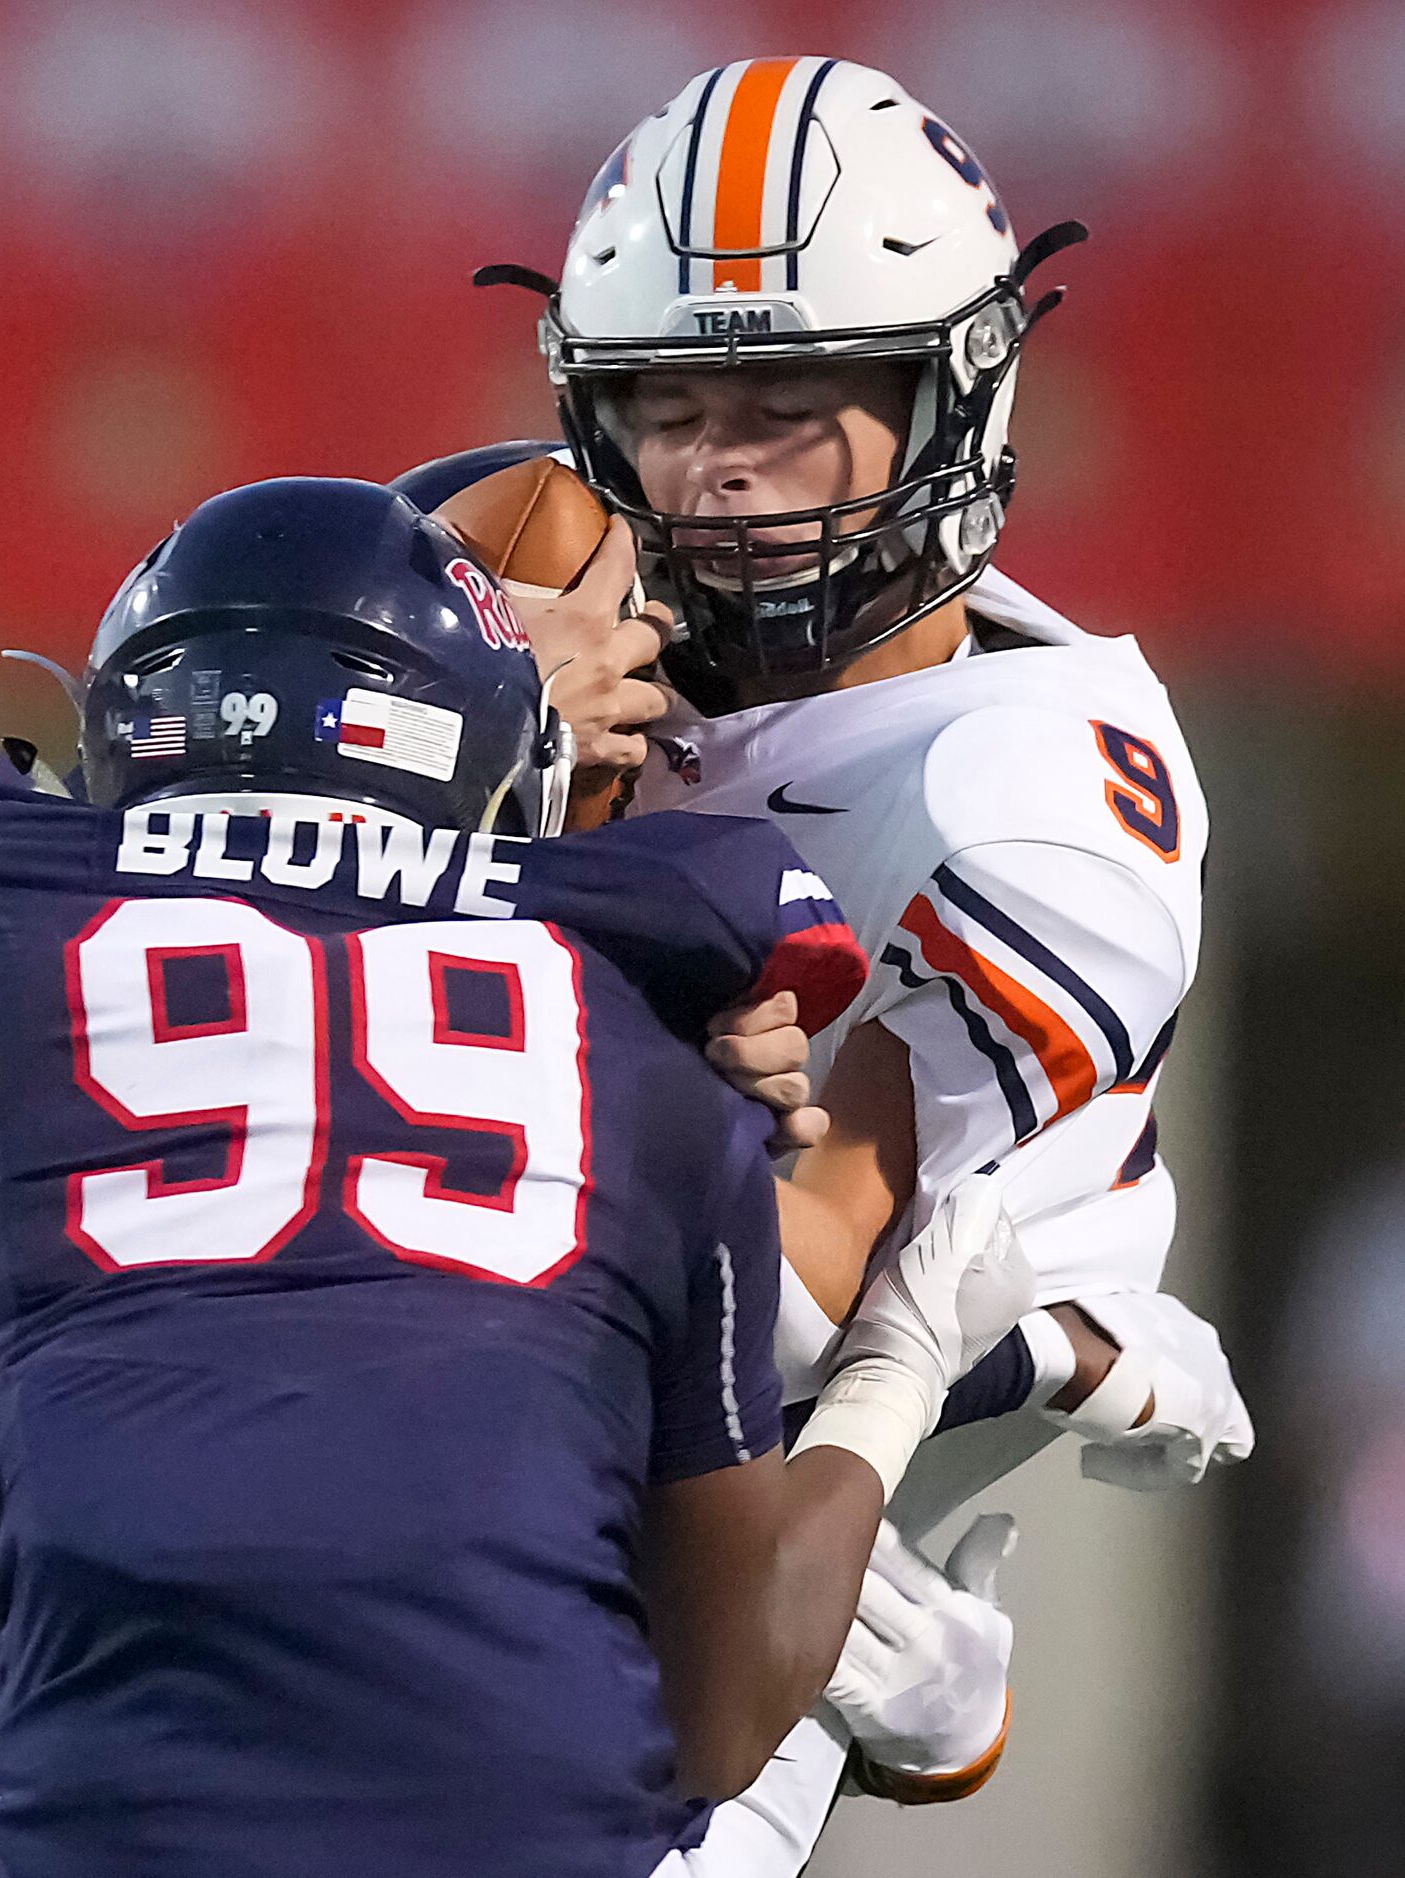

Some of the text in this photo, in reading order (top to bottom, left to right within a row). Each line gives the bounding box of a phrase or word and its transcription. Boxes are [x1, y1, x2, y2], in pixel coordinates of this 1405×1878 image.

[921, 116, 1008, 236] 9
[693, 307, 772, 334] TEAM
[221, 692, 278, 736] 99
[1087, 719, 1181, 864] 9
[116, 808, 532, 918] BLOWE
[63, 897, 594, 1288] 99
